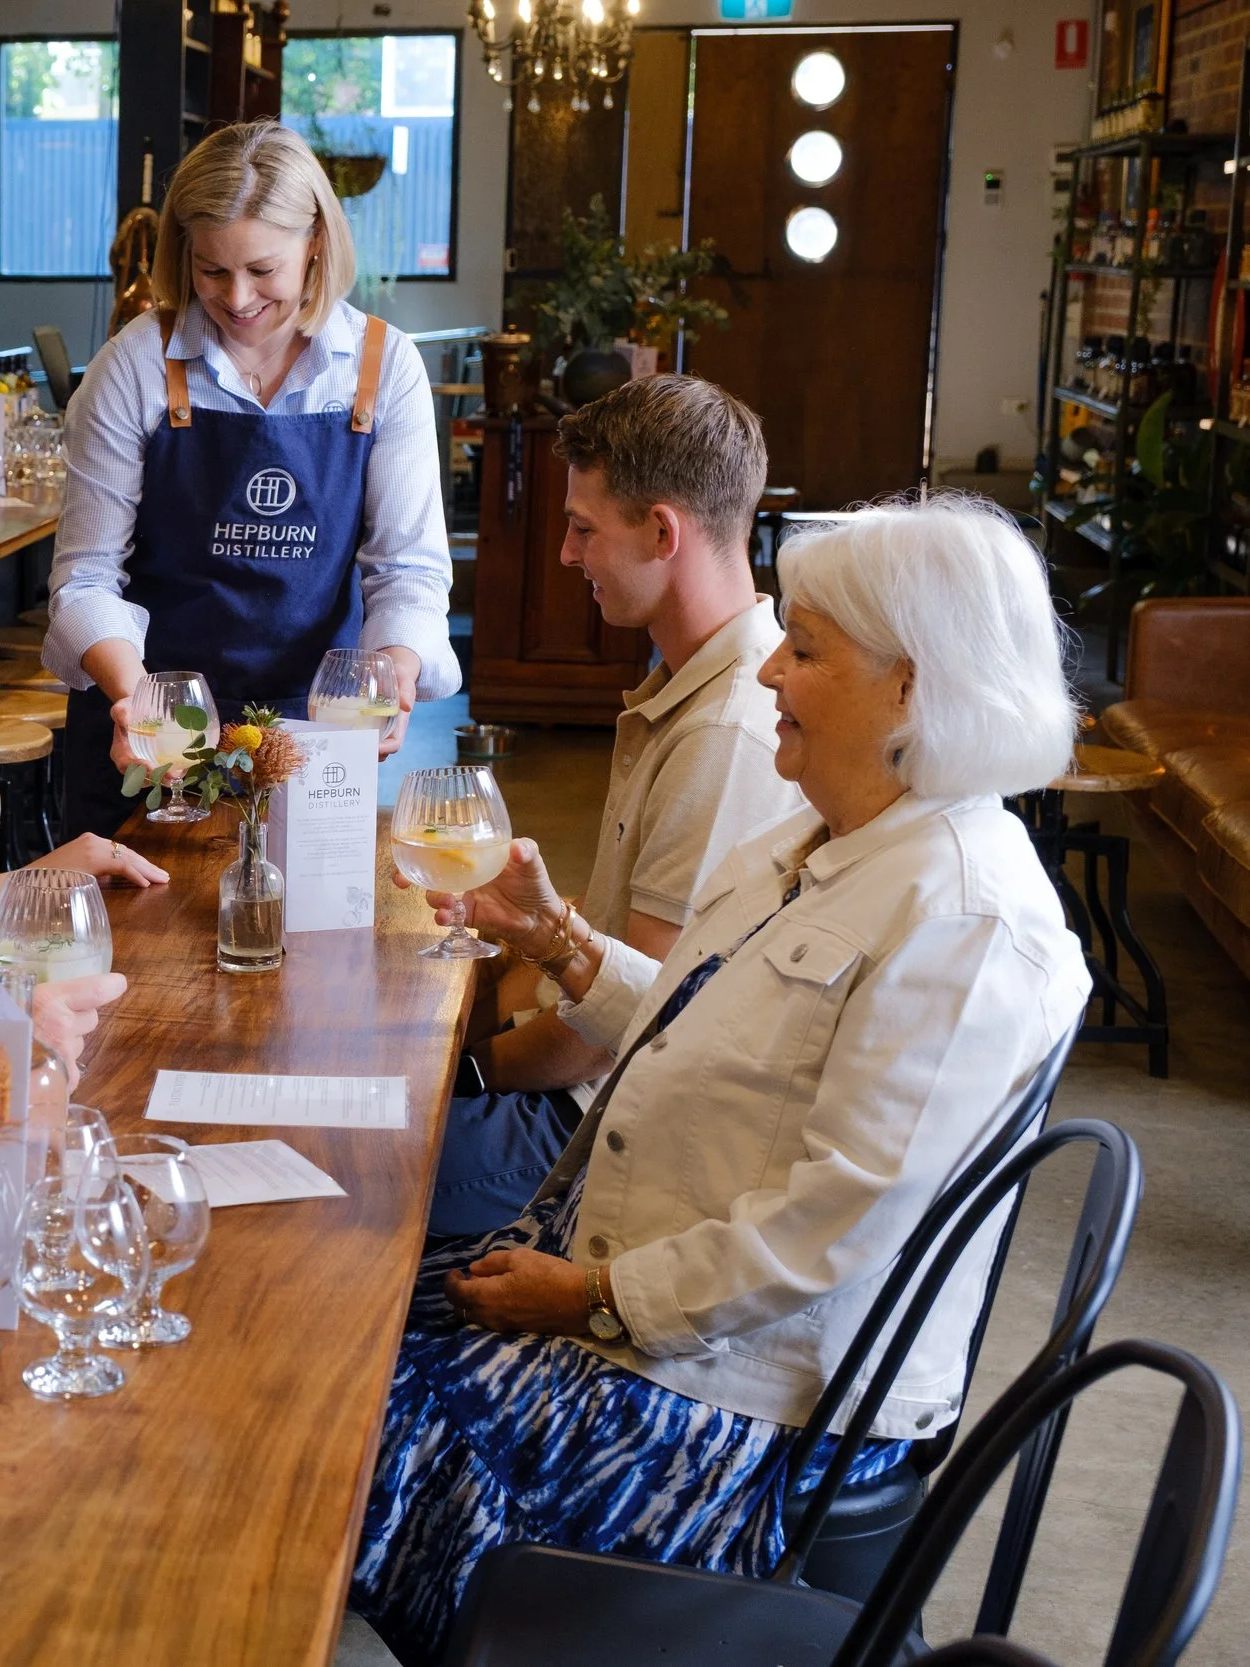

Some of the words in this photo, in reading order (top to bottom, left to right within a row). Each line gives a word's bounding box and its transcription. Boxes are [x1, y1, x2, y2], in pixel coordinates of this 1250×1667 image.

[214, 522, 316, 542] HEPBURN
[212, 543, 314, 559] DISTILLERY
[308, 787, 361, 799] HEPBURN
[308, 799, 361, 810] DISTILLERY
